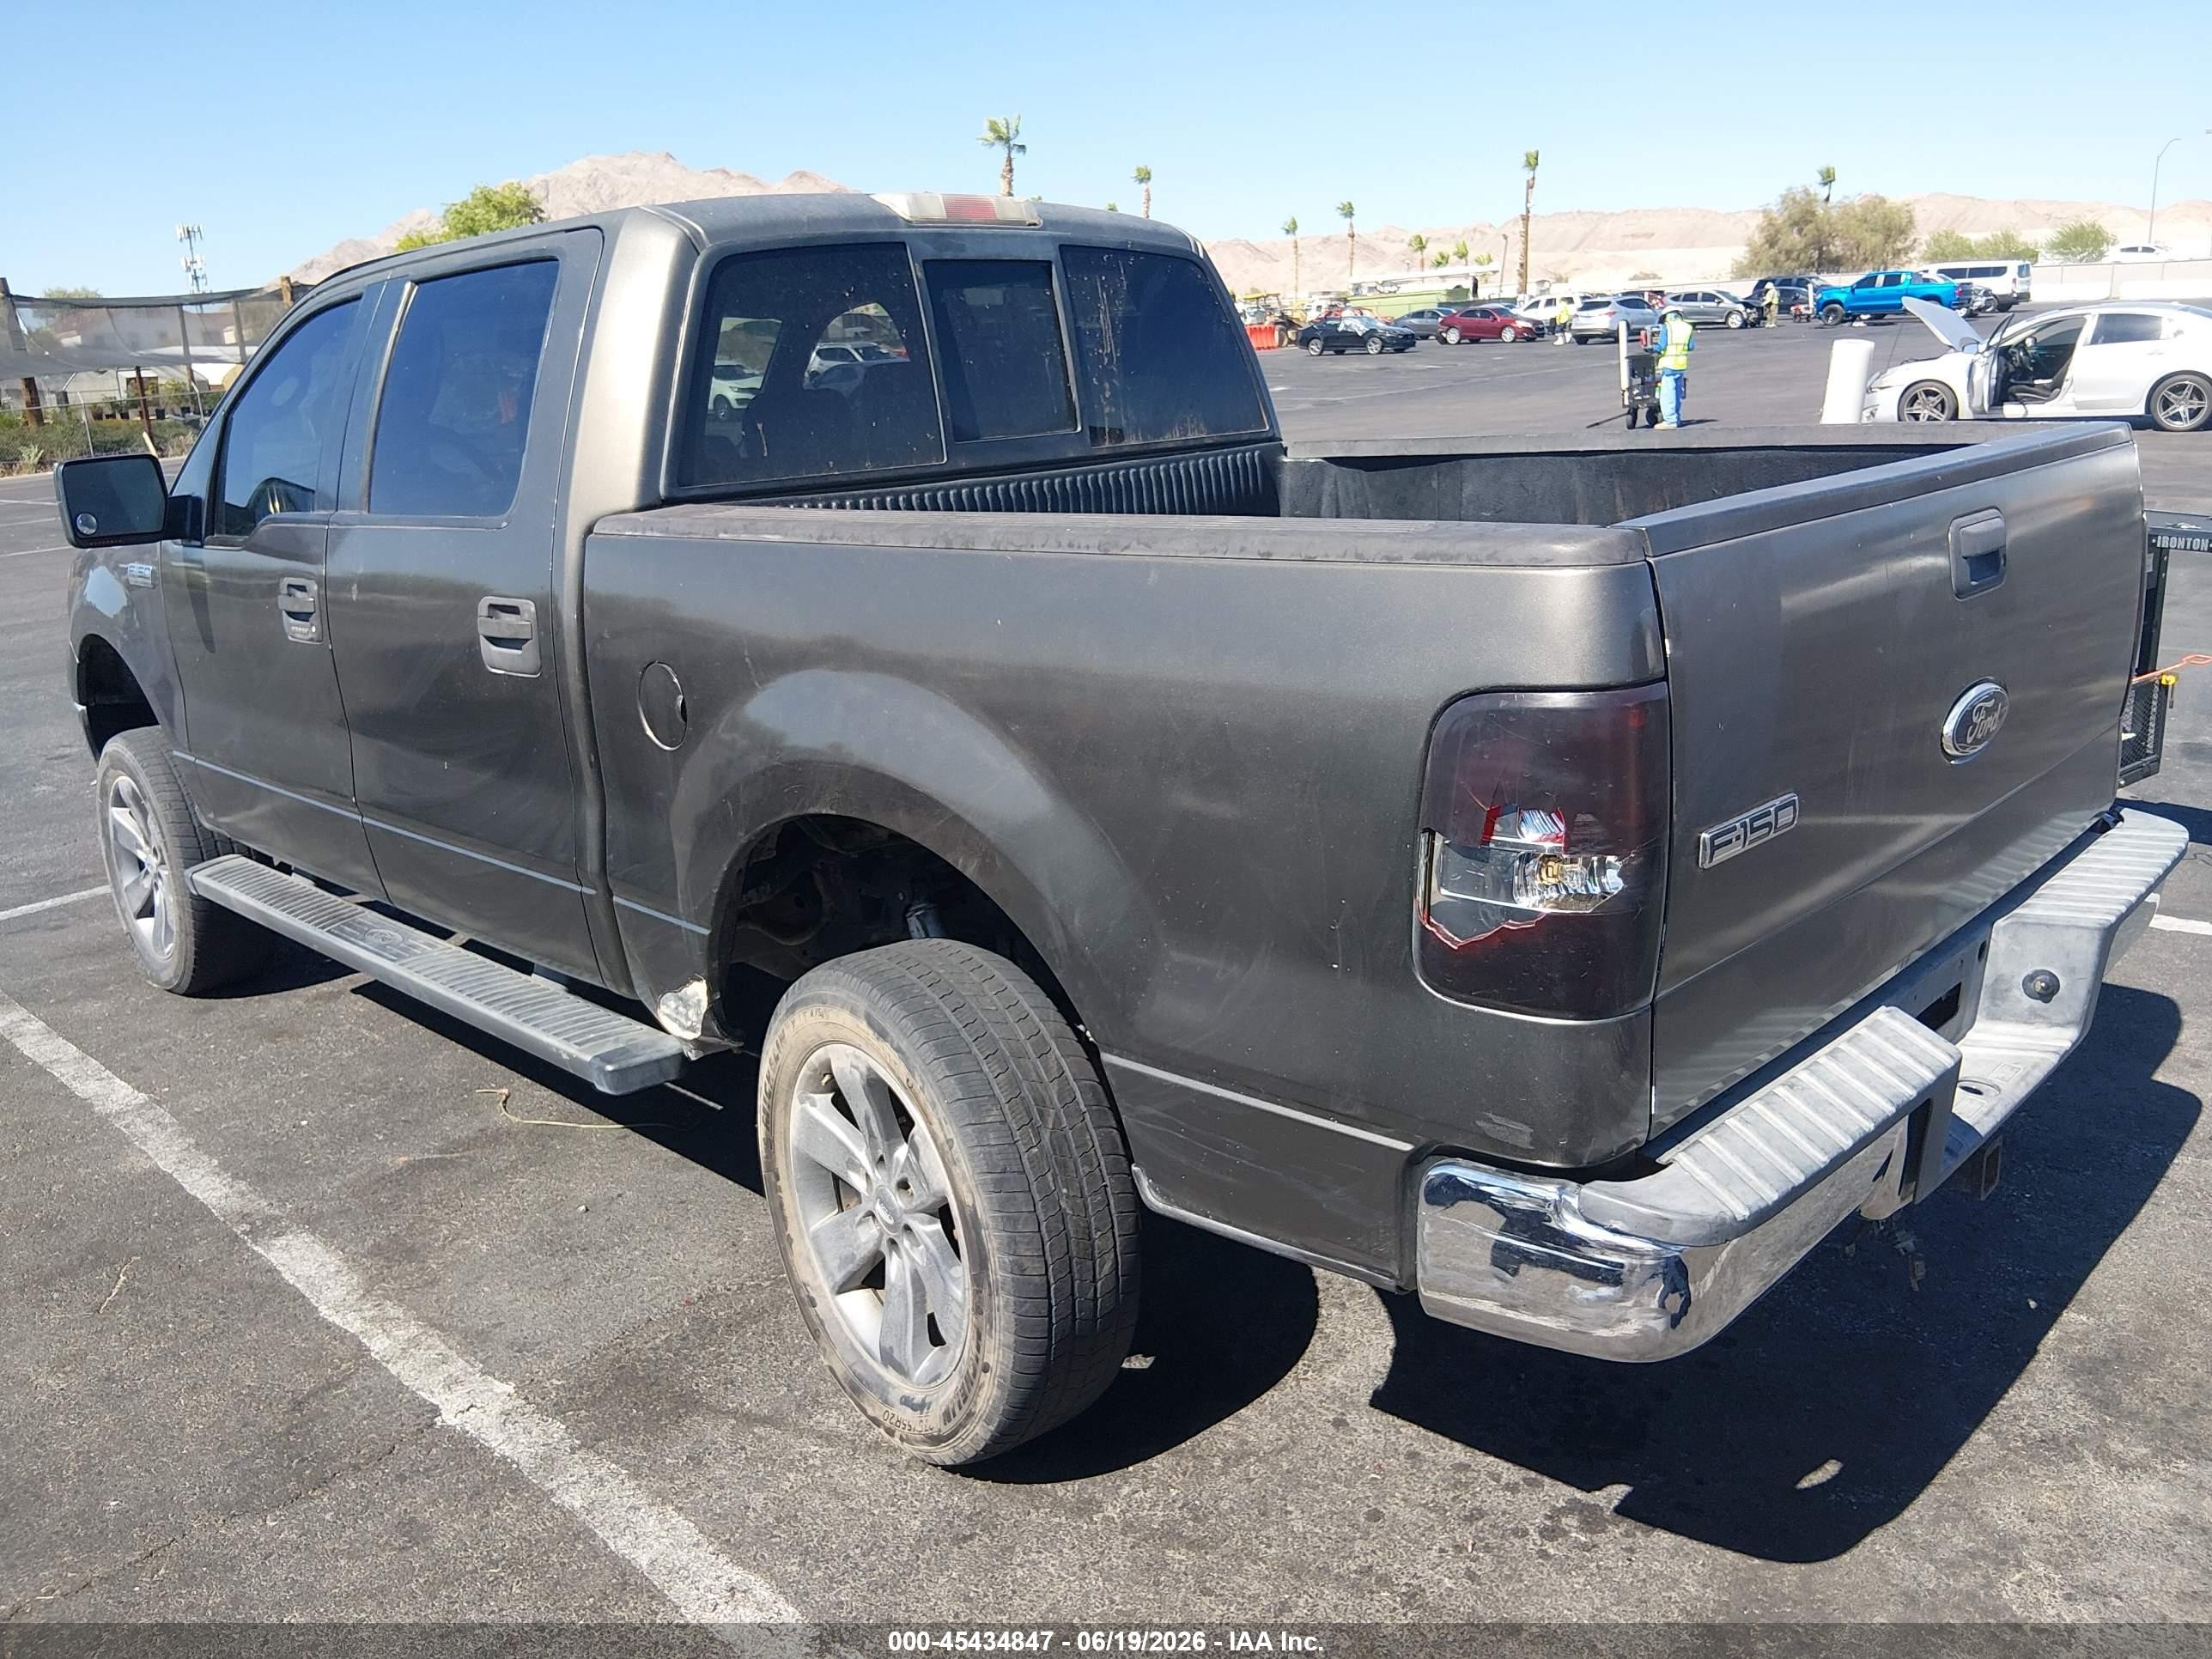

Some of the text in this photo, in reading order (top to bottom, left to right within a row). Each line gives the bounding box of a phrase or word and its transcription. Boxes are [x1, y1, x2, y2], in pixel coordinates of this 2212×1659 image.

[2156, 535, 2209, 551] IRONTON
[1966, 698, 2002, 744] Ford
[1707, 798, 1797, 865] F-150
